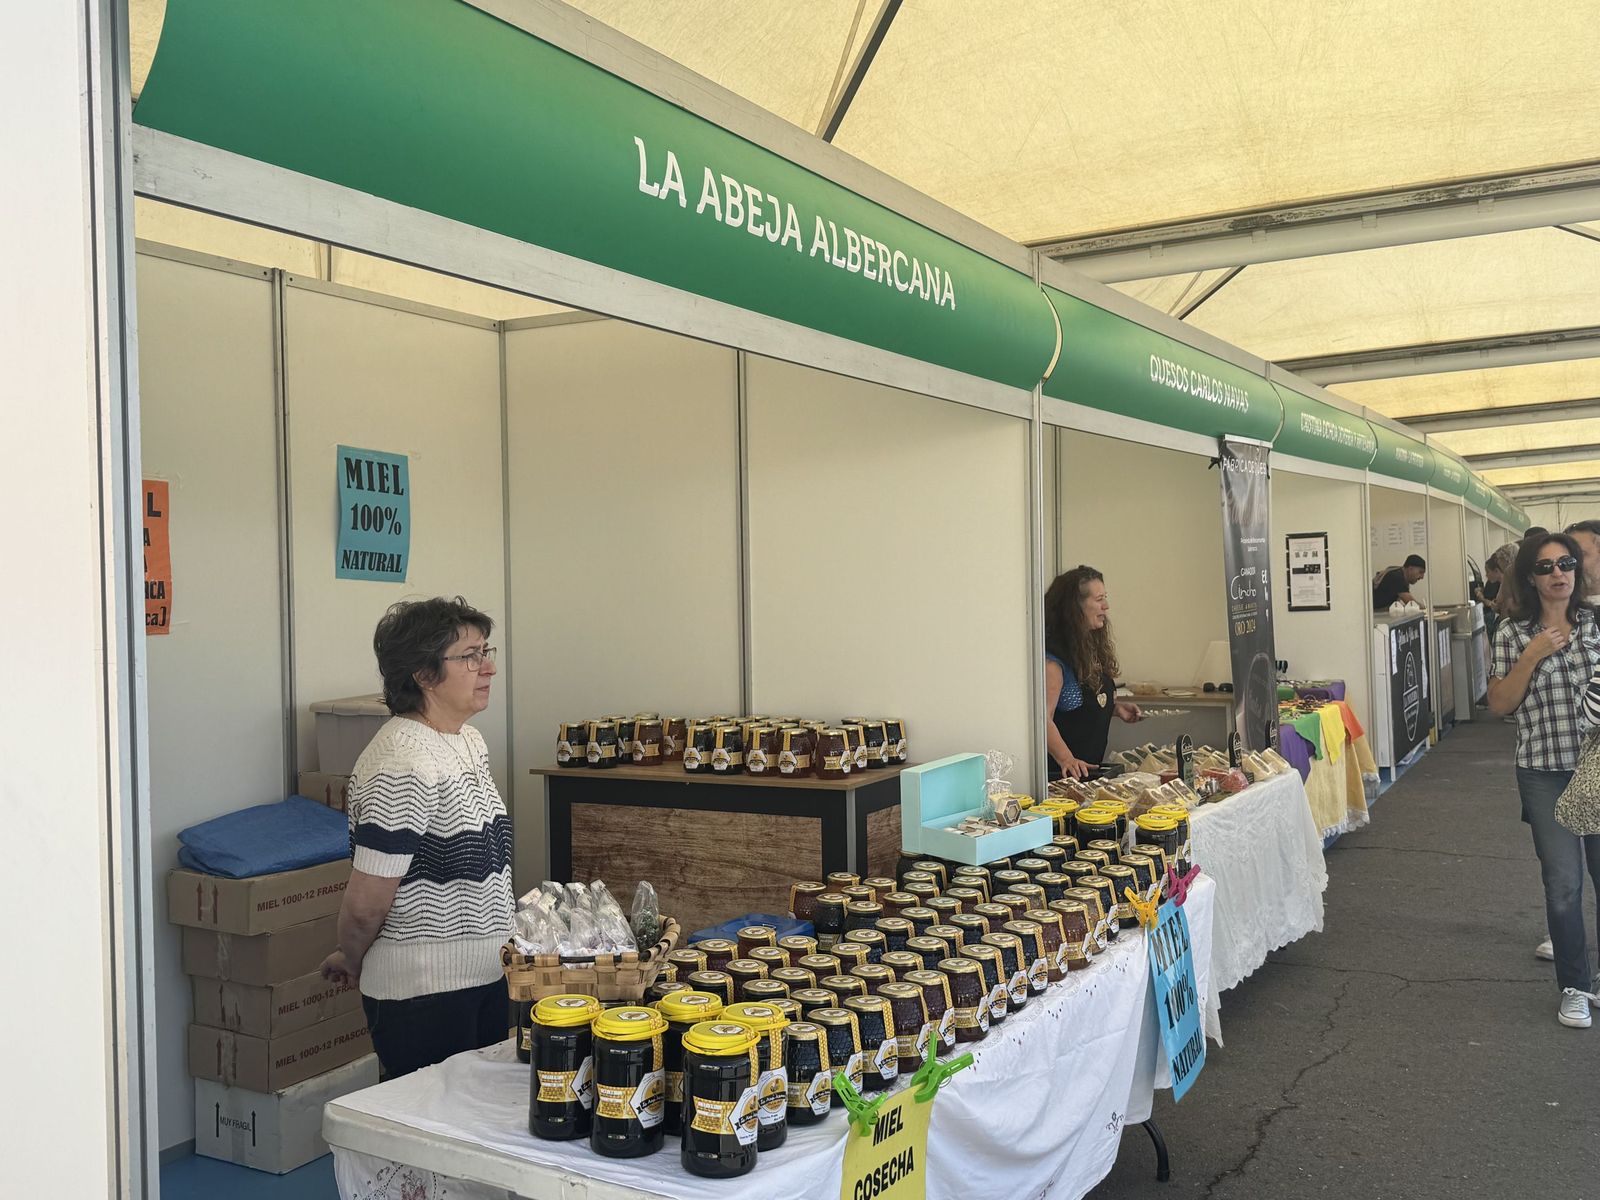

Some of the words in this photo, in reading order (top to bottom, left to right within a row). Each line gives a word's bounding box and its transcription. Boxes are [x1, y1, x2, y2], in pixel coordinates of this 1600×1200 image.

[633, 135, 687, 208] LA
[696, 166, 803, 253] ABEJA
[809, 215, 956, 311] ALBERCANA
[1150, 354, 1189, 393] QUESOS
[1190, 370, 1223, 405] CARLOS
[1223, 383, 1249, 414] NAVAS
[344, 457, 404, 495] MIEL
[350, 503, 402, 535] 100%
[341, 549, 402, 573] NATURAL
[257, 898, 280, 912] MIEL
[281, 889, 316, 905] 1000-12
[1150, 911, 1189, 976] MIEL
[278, 1001, 300, 1016] MIEL
[302, 987, 334, 1007] 1000-12
[1163, 969, 1194, 1030] 100%
[275, 1053, 298, 1069] MIEL
[299, 1040, 332, 1059] 1000-12
[1171, 1027, 1202, 1085] NATURAL
[220, 1115, 232, 1126] MUY
[232, 1119, 252, 1131] FRAGIL
[873, 1104, 904, 1147] MIEL
[854, 1146, 915, 1200] COSECHA
